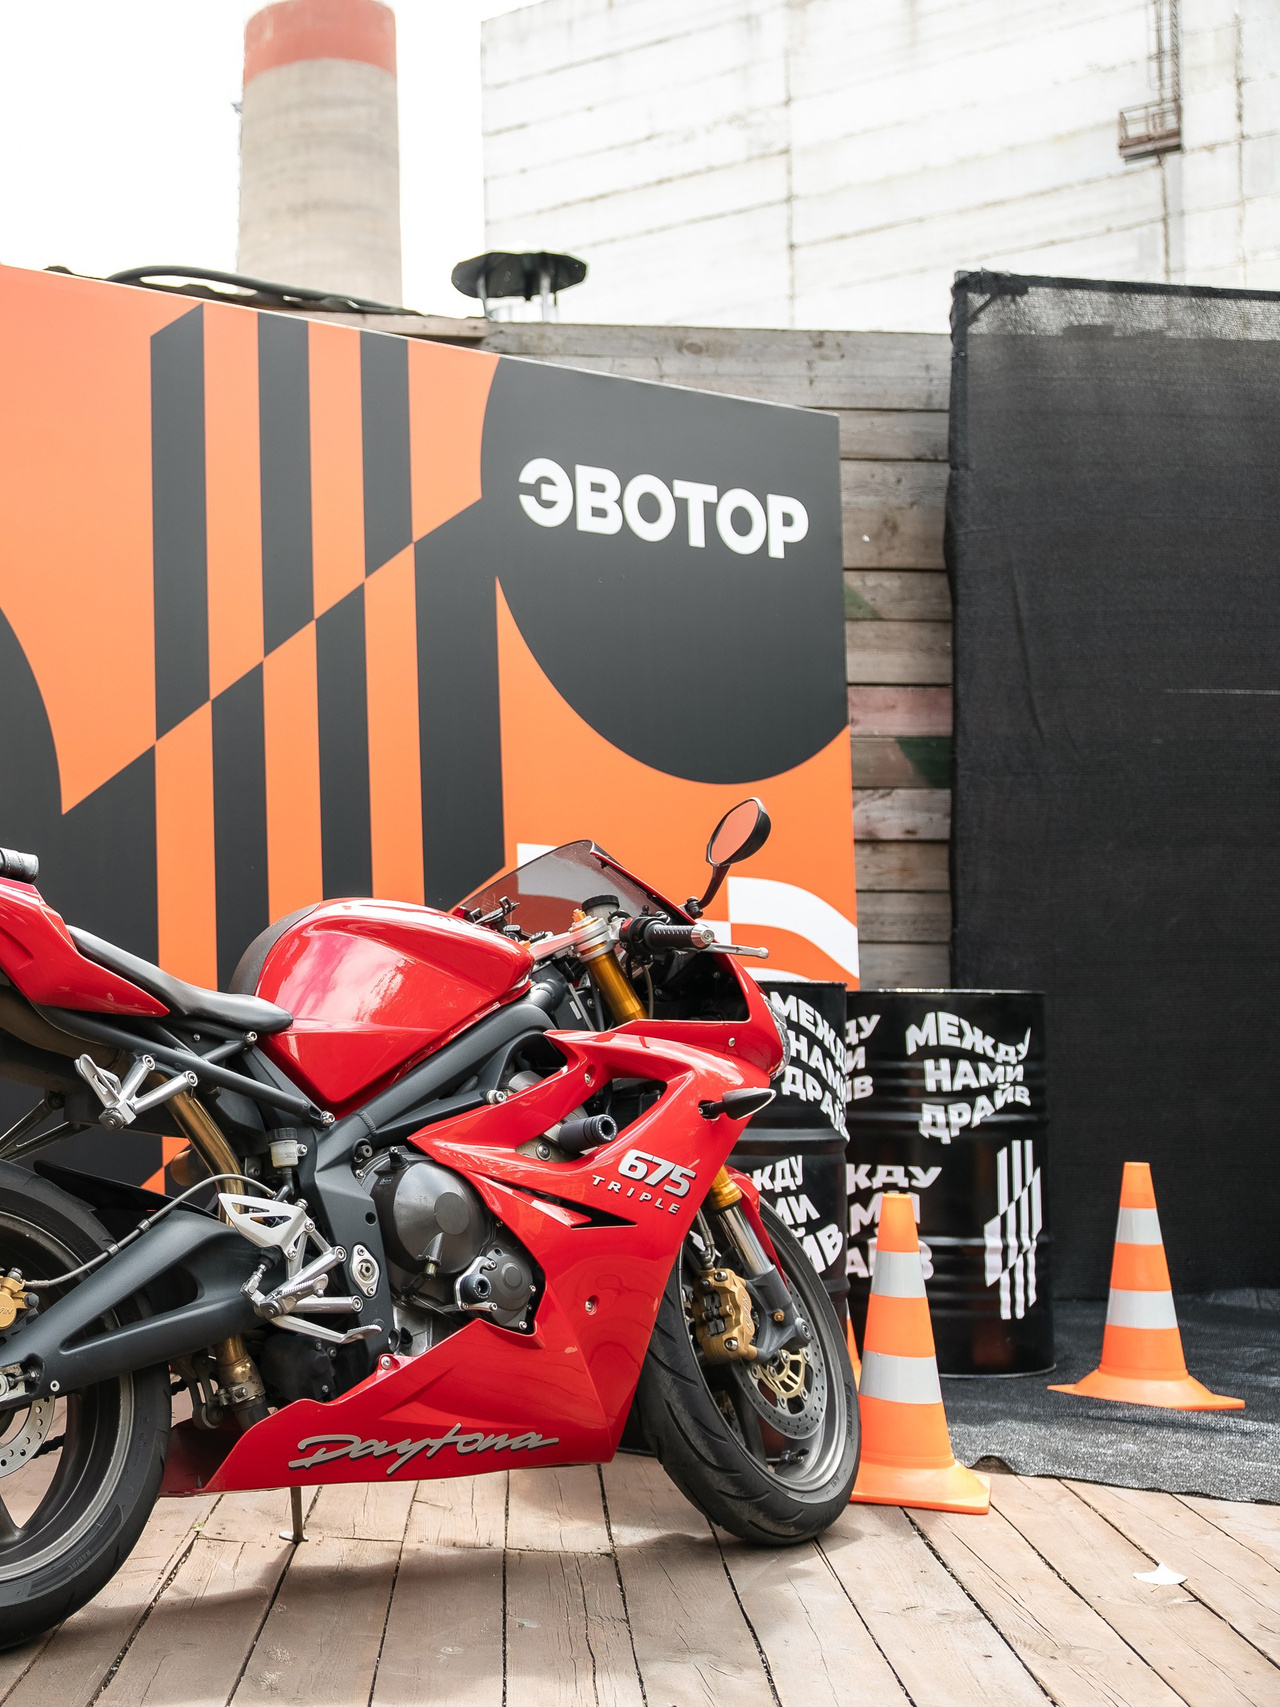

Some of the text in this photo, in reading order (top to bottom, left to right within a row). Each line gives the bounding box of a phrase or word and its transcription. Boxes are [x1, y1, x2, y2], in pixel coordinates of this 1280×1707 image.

[518, 458, 809, 559] ЭВОТОР
[905, 1011, 1031, 1064] МЕЖДУ
[924, 1058, 1024, 1092] НАМИ
[919, 1083, 1031, 1144] ДРАЙВ
[592, 1174, 681, 1215] TRIPLE
[618, 1149, 697, 1197] 675
[288, 1422, 560, 1476] Daytona
